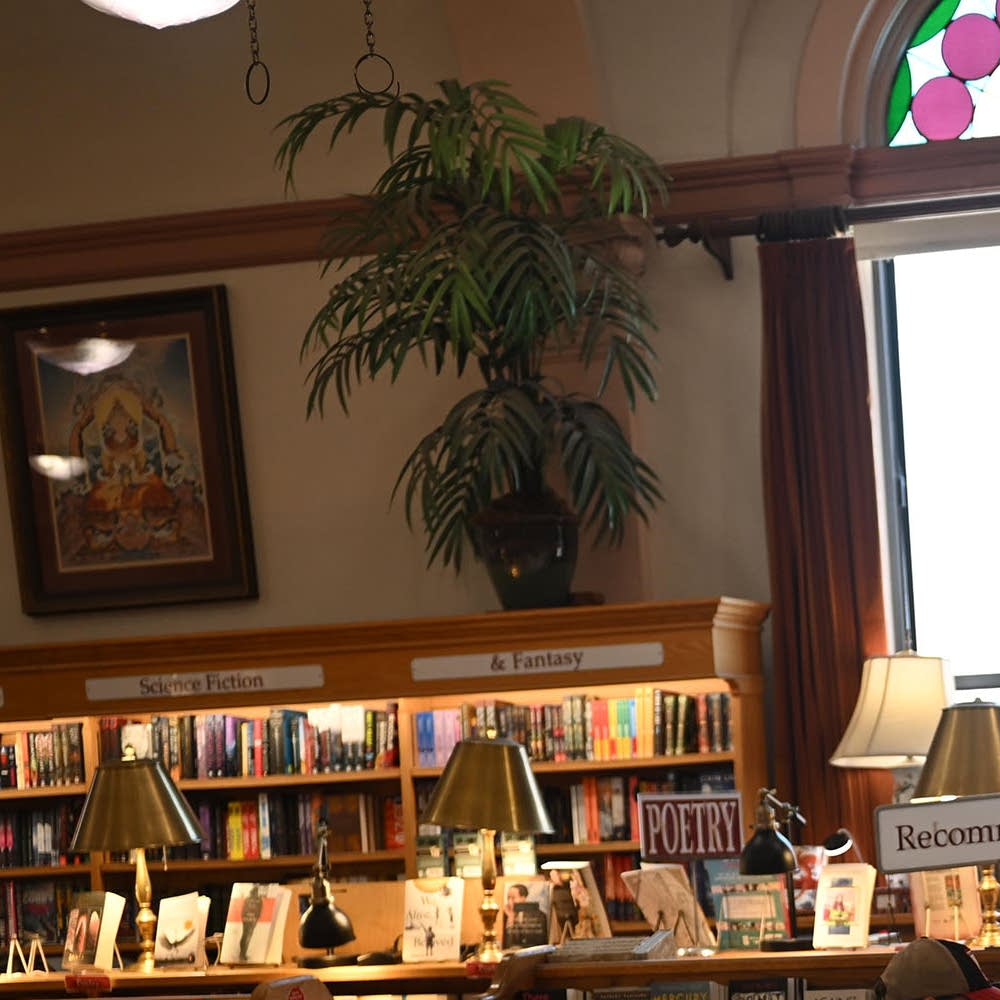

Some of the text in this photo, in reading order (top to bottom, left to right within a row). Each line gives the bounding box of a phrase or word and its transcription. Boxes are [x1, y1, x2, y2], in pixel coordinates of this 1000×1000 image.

[490, 650, 584, 672] & Fantasy
[139, 671, 264, 696] Science Fiction
[646, 800, 738, 855] POETRY
